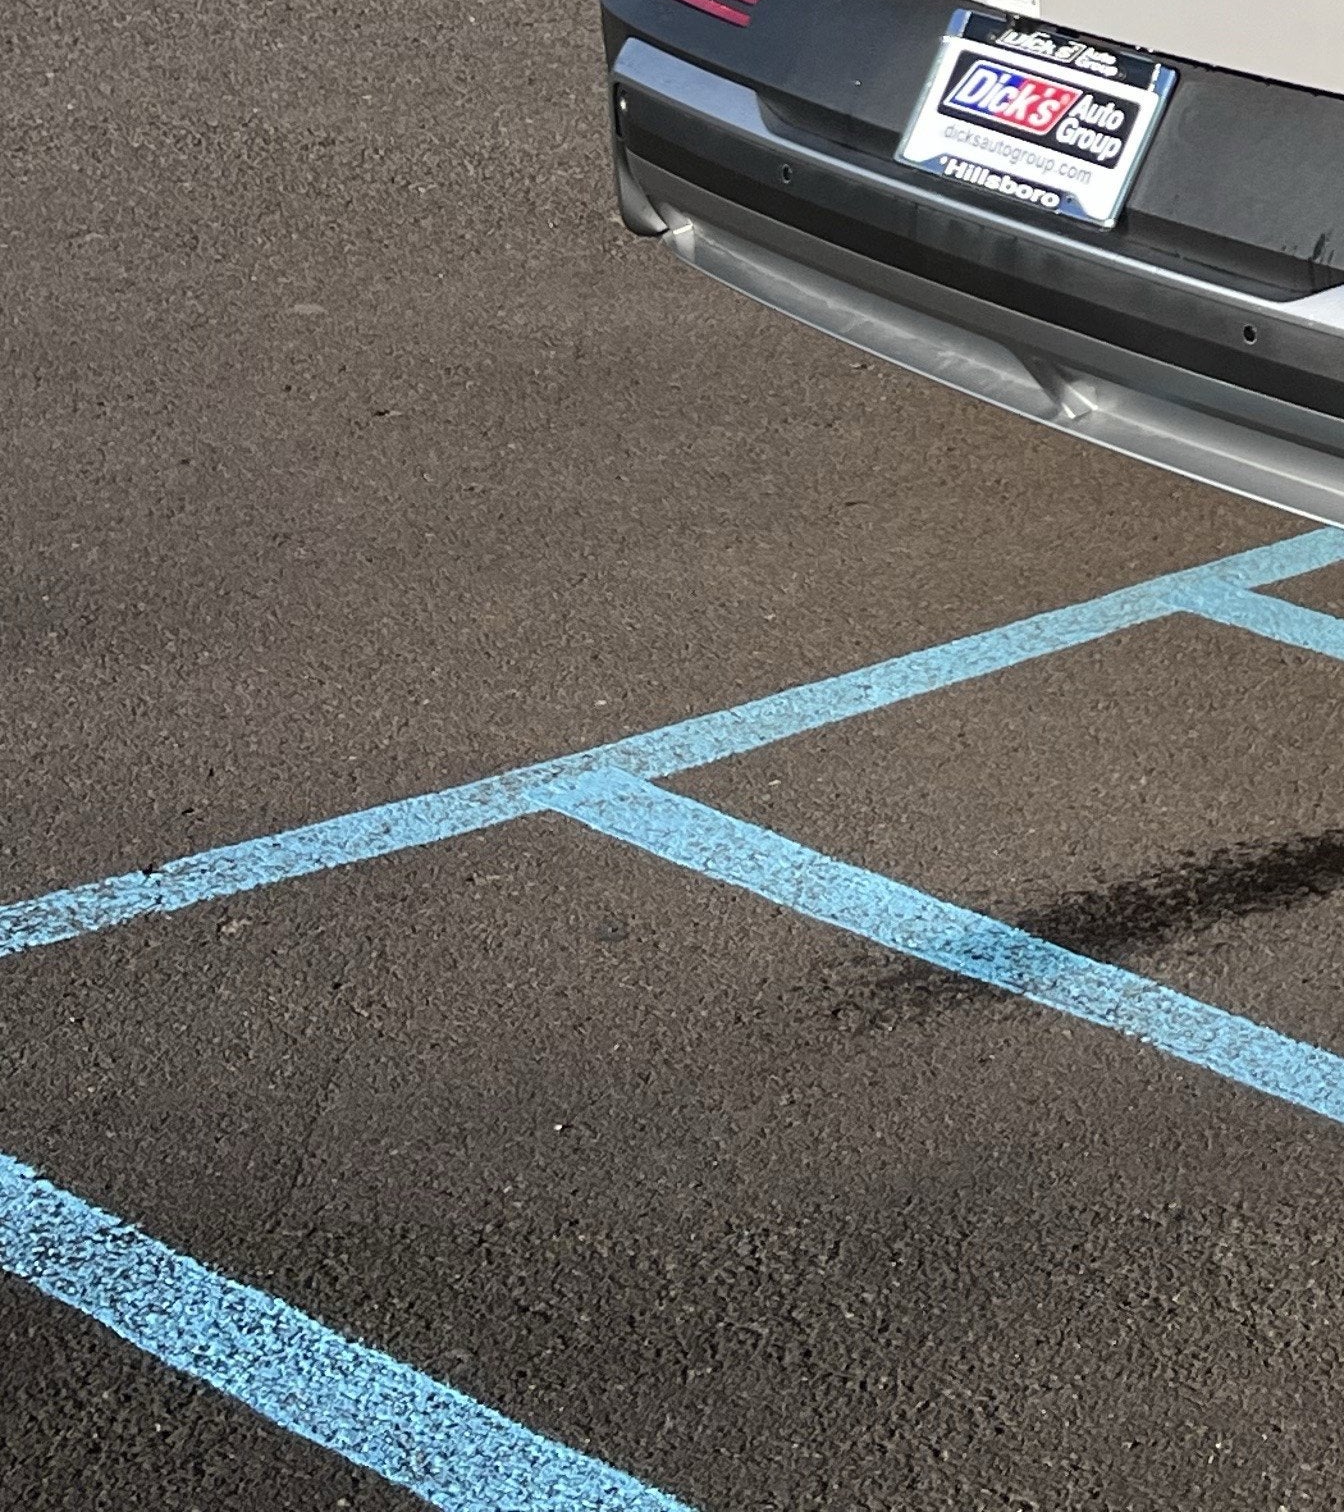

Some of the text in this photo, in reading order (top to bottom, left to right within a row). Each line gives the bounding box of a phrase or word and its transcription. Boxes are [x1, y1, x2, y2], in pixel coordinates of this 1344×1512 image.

[954, 67, 1062, 127] Dick's
[1068, 94, 1125, 131] Auto
[943, 124, 1092, 185] dicksautogroup.com
[1056, 117, 1123, 161] Group
[944, 158, 1061, 208] Hillsboro
